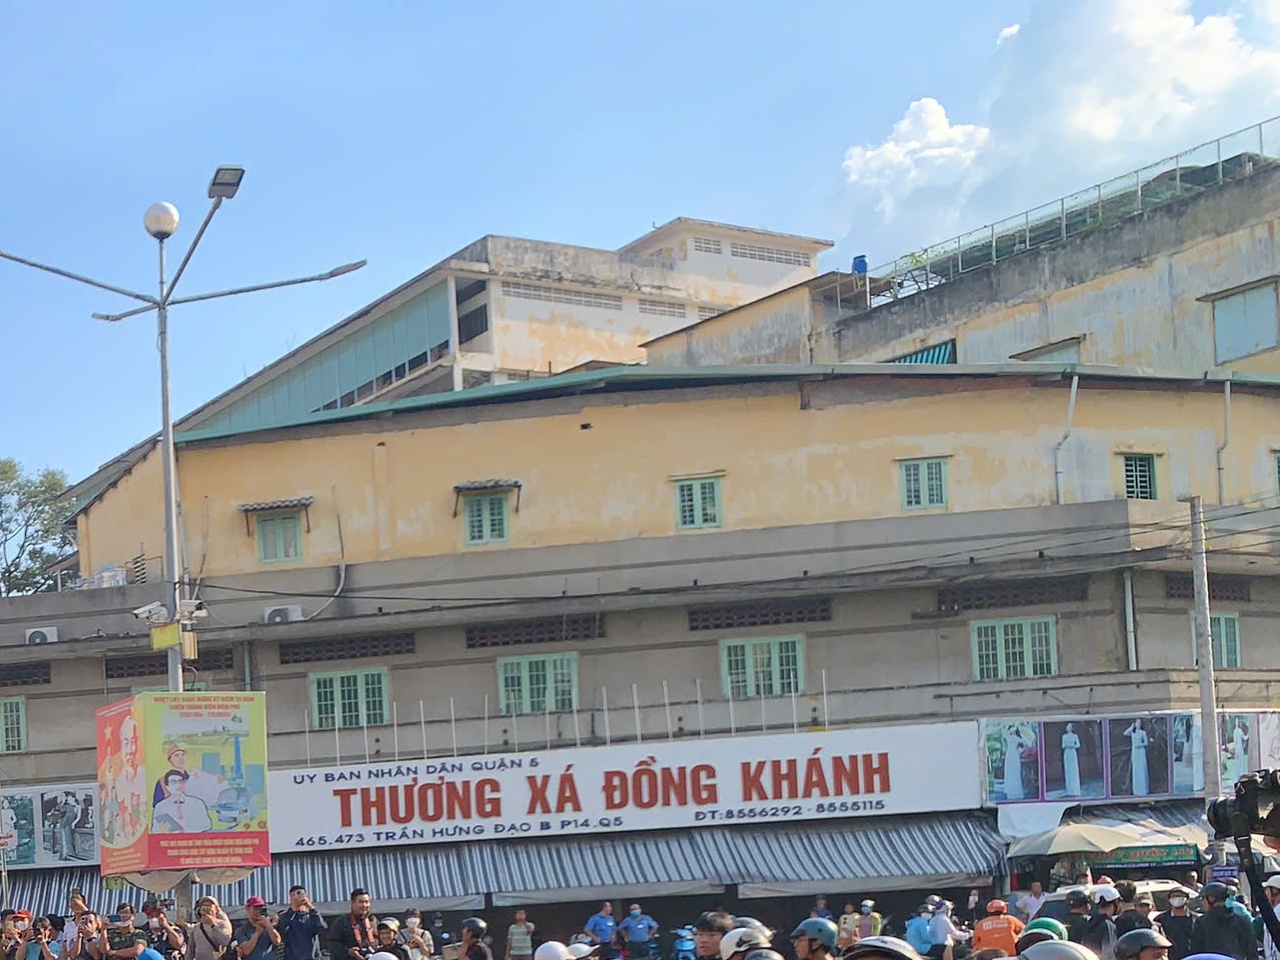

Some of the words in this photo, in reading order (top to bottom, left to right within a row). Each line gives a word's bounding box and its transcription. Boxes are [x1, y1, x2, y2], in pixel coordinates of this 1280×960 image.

[324, 771, 361, 783] BAN
[368, 764, 419, 779] NHÂN
[426, 761, 464, 775] DÂN
[471, 757, 522, 772] QUẬN
[529, 757, 540, 768] 5
[332, 775, 502, 827] THƯƠNG
[525, 763, 582, 815] XÁ
[602, 755, 719, 811] ĐỒNG
[741, 747, 891, 802] KHÁNH
[432, 824, 485, 839] HƯNG
[494, 821, 532, 836] ĐẠO
